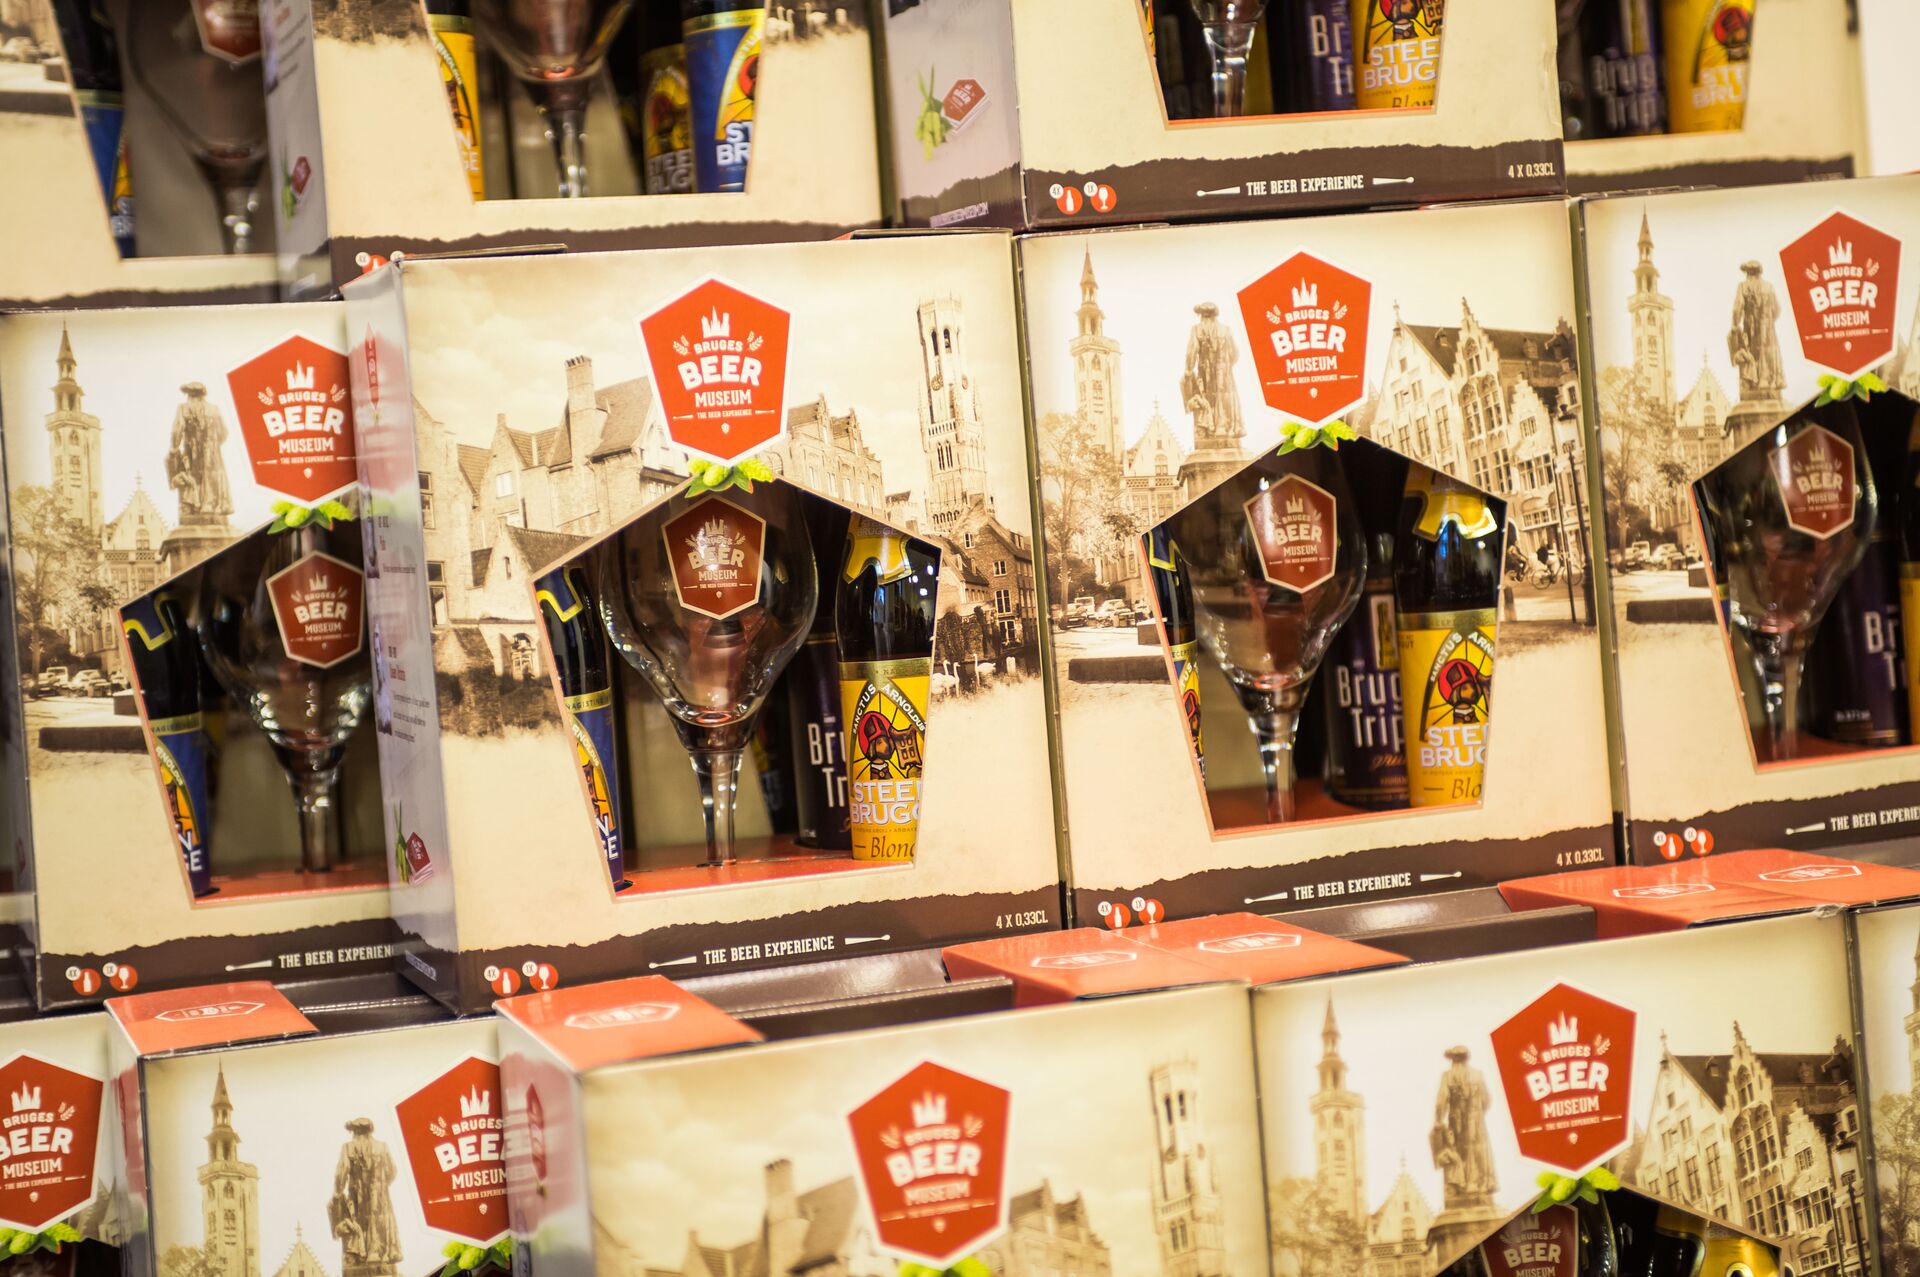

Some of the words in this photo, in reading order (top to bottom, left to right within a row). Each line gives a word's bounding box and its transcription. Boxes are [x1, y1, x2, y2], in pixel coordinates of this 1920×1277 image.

[1508, 165, 1515, 179] 4
[1517, 164, 1524, 178] X
[1245, 181, 1268, 197] THE
[1270, 178, 1298, 195] BEER
[1300, 174, 1365, 193] EXPERIENCE
[1823, 265, 1864, 281] BRUGES
[1809, 280, 1878, 313] BEER
[1284, 308, 1330, 323] BRUGES
[1823, 310, 1870, 328] MUSEUM
[693, 339, 744, 355] BRUGES
[1270, 322, 1347, 357] BEER
[677, 354, 762, 391] BEER
[1286, 355, 1338, 374] MUSEUM
[278, 391, 327, 405] BRUGES
[694, 389, 752, 408] MUSEUM
[262, 405, 345, 438] BEER
[278, 437, 335, 454] MUSEUM
[1275, 523, 1323, 546] BEER
[688, 546, 745, 570] BEER
[1283, 545, 1318, 557] MUSEUM
[698, 569, 738, 581] MUSEUM
[293, 601, 348, 624] BEER
[305, 622, 342, 634] MUSEUM
[1429, 632, 1463, 682] SANCTUS
[853, 684, 877, 734] SANCTUS
[881, 683, 926, 732] ARNOLDUS
[1830, 815, 1850, 831] THE
[1852, 811, 1877, 829] BEER
[1556, 853, 1563, 867] 4
[1565, 852, 1573, 866] X
[1293, 886, 1315, 901] THE
[1317, 881, 1345, 898] BEER
[1348, 873, 1412, 893] EXPERIENCE
[996, 915, 1003, 929] 4
[1005, 914, 1013, 928] X
[1015, 910, 1049, 927] 0,33CL
[278, 953, 301, 968] THE
[305, 950, 335, 966] BEER
[703, 950, 726, 965] THE
[730, 945, 761, 962] BEER
[765, 936, 835, 958] EXPERIENCE
[1541, 1044, 1591, 1063] BRUGES
[1526, 1060, 1610, 1101] BEER
[1543, 1095, 1600, 1119] MUSEUM
[3, 1112, 55, 1128] BRUGES
[3, 1157, 62, 1180] MUSEUM
[886, 1141, 982, 1187] BEER
[904, 1179, 970, 1206] MUSEUM
[1503, 1242, 1562, 1268] BEER
